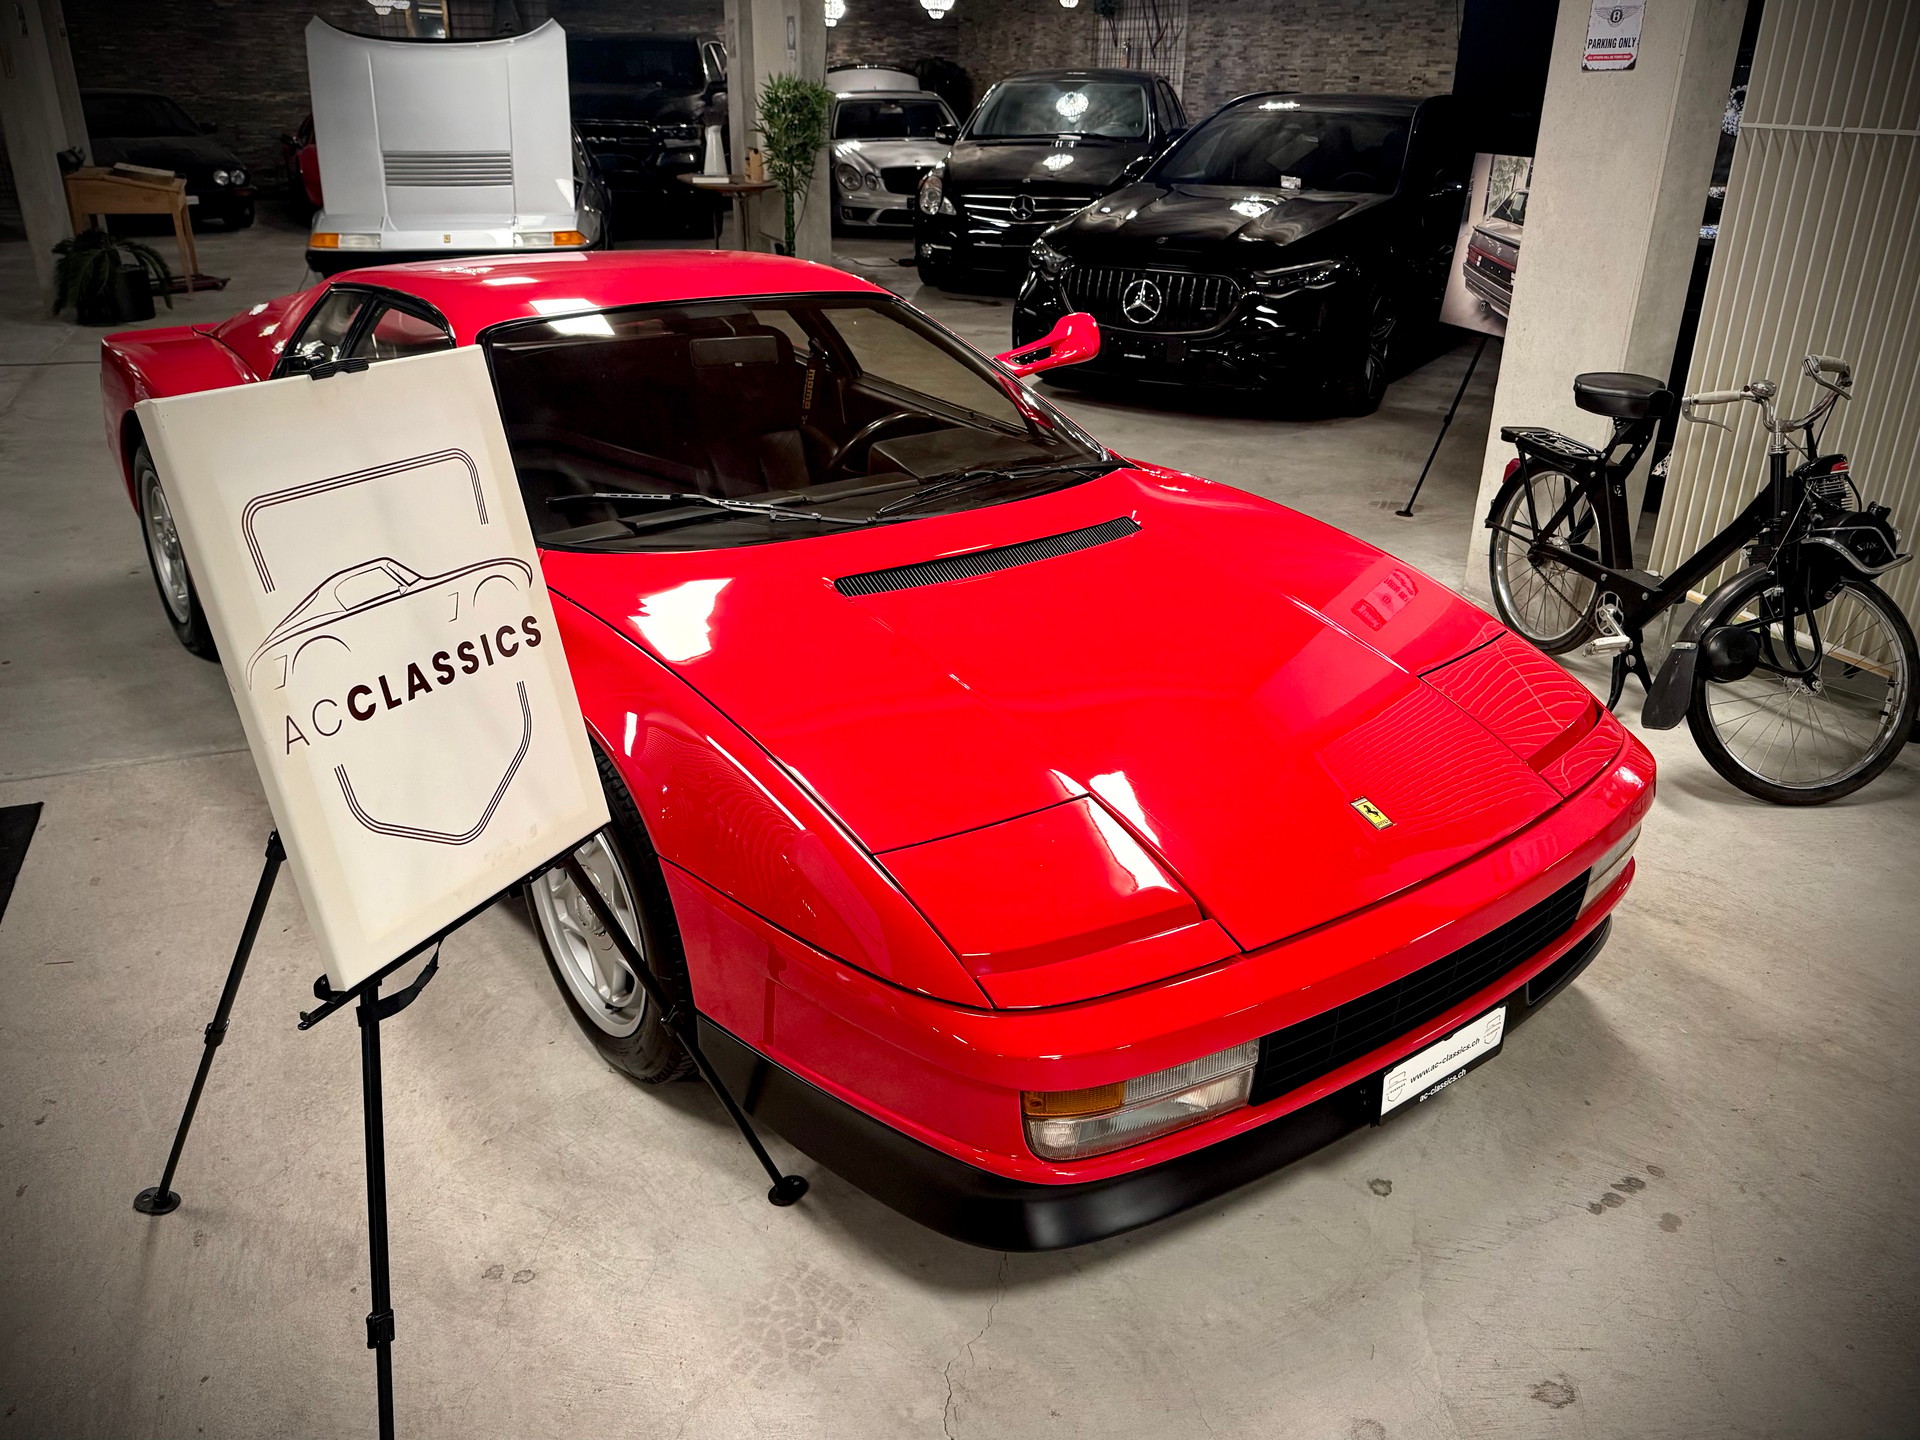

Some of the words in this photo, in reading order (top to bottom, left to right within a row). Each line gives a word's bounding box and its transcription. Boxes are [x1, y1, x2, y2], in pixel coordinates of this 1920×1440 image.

[1587, 38, 1617, 49] PARKING
[1618, 37, 1637, 48] ONLY
[804, 369, 816, 409] momo
[1410, 1037, 1480, 1083] www.ac-classics.ch
[1419, 1068, 1467, 1102] ac-classics.ch
